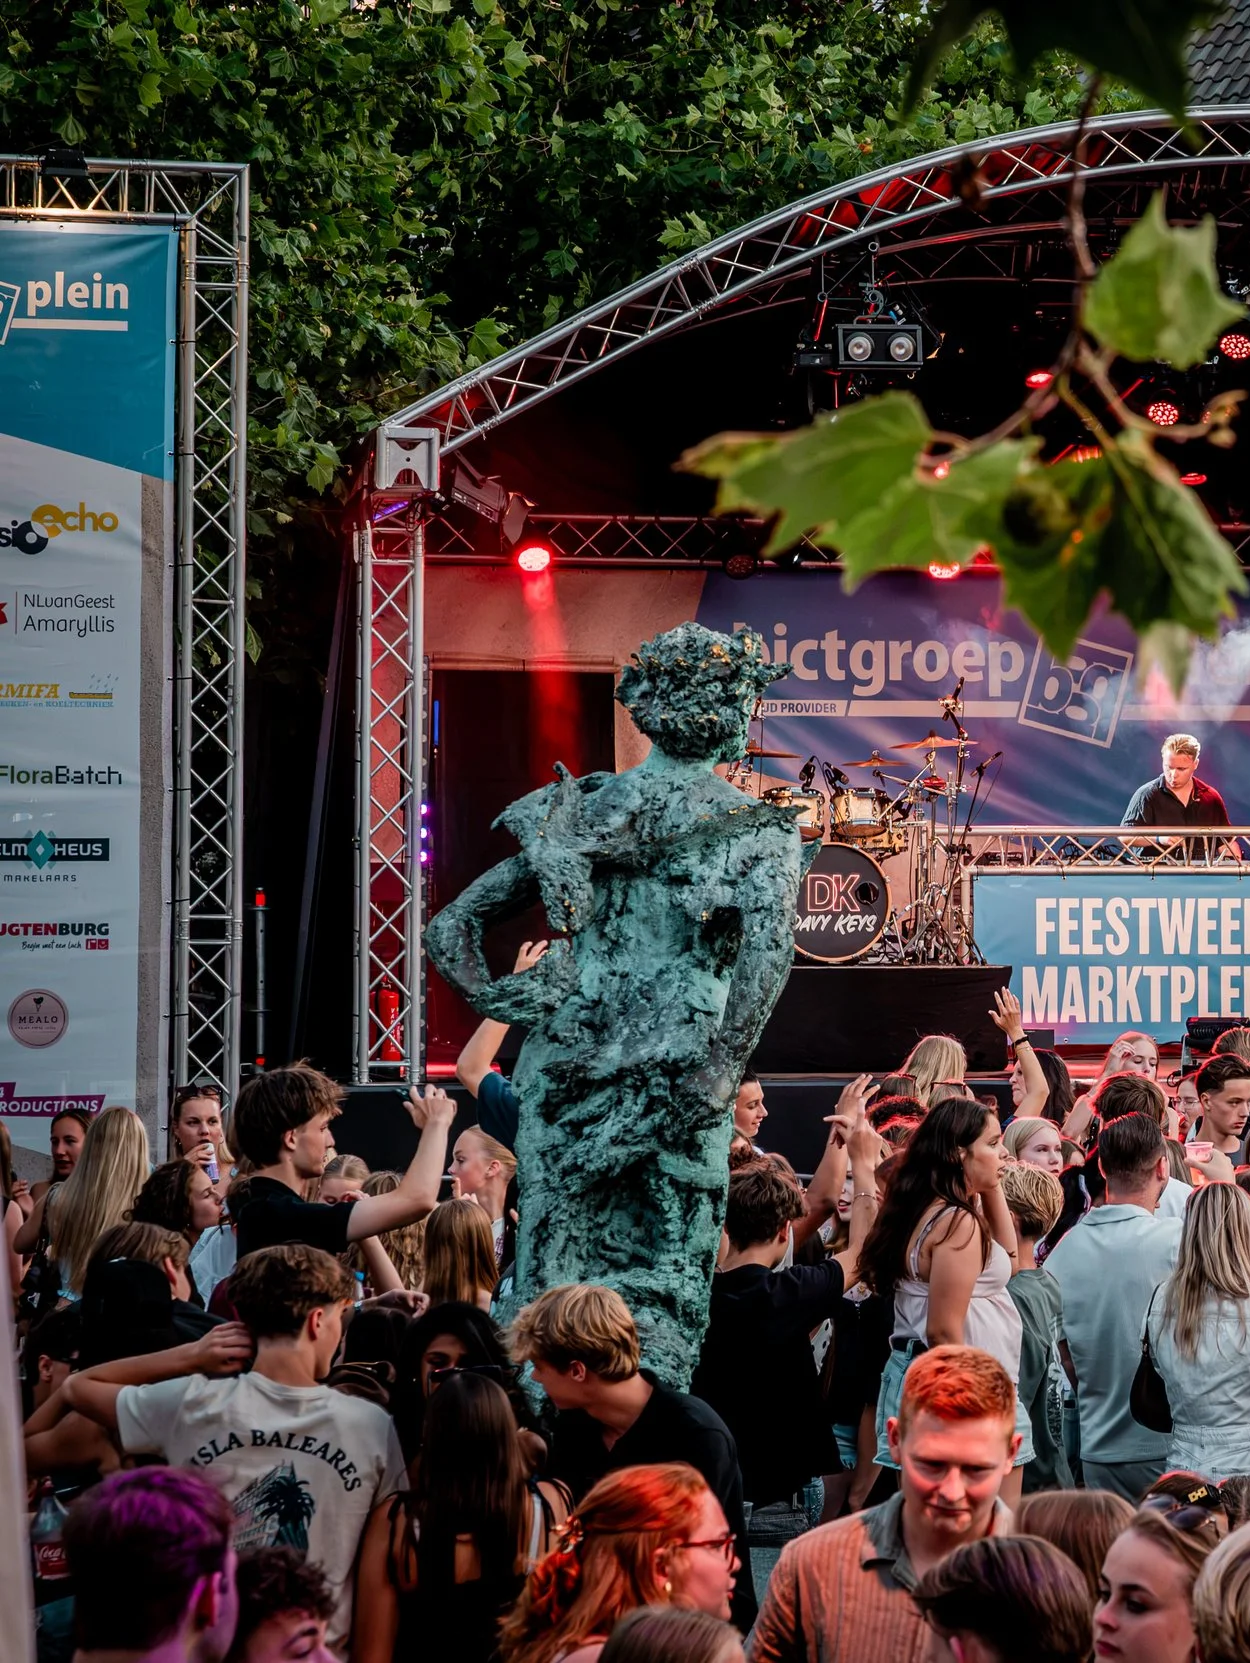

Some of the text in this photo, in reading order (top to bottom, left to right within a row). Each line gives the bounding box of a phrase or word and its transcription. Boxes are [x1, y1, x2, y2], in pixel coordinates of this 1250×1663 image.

[27, 271, 129, 317] plein
[23, 594, 115, 609] NLvanGeest
[23, 616, 115, 638] Amaryllis
[733, 622, 1025, 697] ictgroep
[780, 703, 837, 713] PROVIDER
[0, 766, 122, 784] FloraBatch
[54, 843, 103, 856] HEUS
[4, 874, 77, 883] MAKELAARS
[807, 874, 861, 912] DK
[833, 913, 878, 936] KEYS
[18, 1015, 58, 1024] MEALO
[251, 1429, 362, 1493] BALEARES
